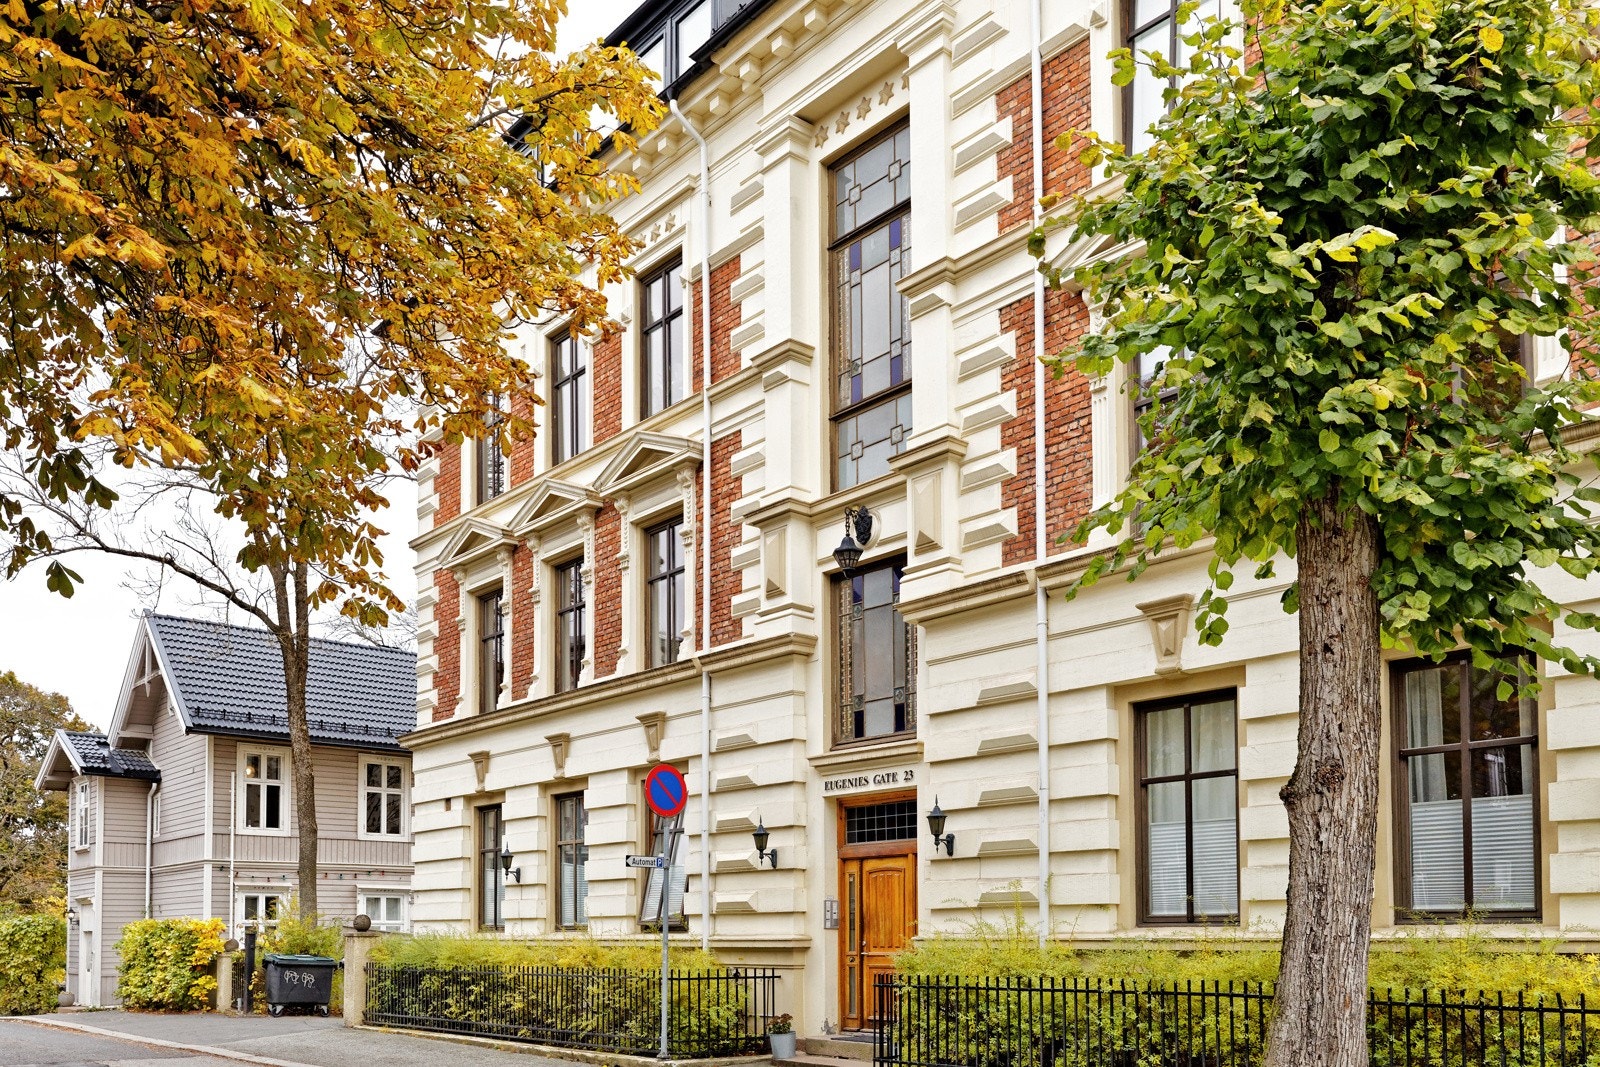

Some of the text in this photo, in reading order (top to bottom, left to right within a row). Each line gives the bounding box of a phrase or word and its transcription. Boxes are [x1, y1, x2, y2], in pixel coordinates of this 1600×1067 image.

[824, 770, 914, 791] EUGENIES GATE 23
[632, 857, 656, 866] Automat
